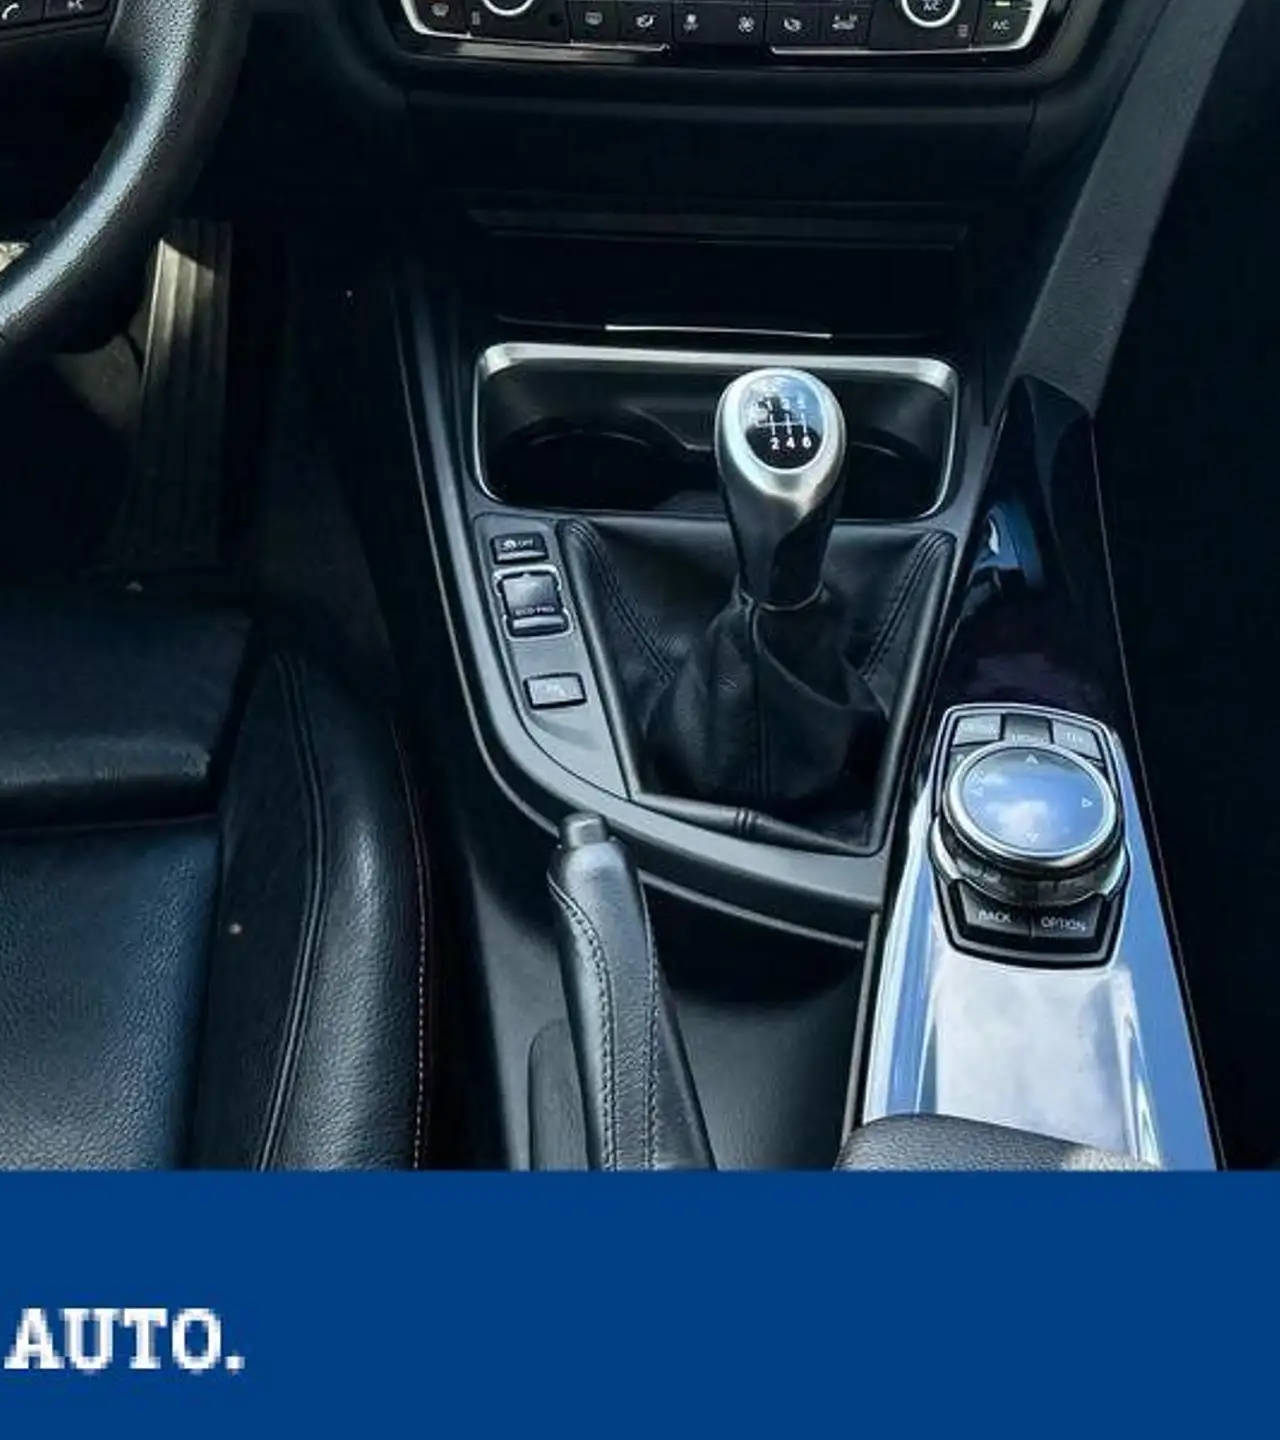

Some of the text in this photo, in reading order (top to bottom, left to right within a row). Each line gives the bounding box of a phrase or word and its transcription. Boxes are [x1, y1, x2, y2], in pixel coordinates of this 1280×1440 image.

[770, 436, 812, 450] 2 4 6
[1039, 915, 1087, 933] OPTION
